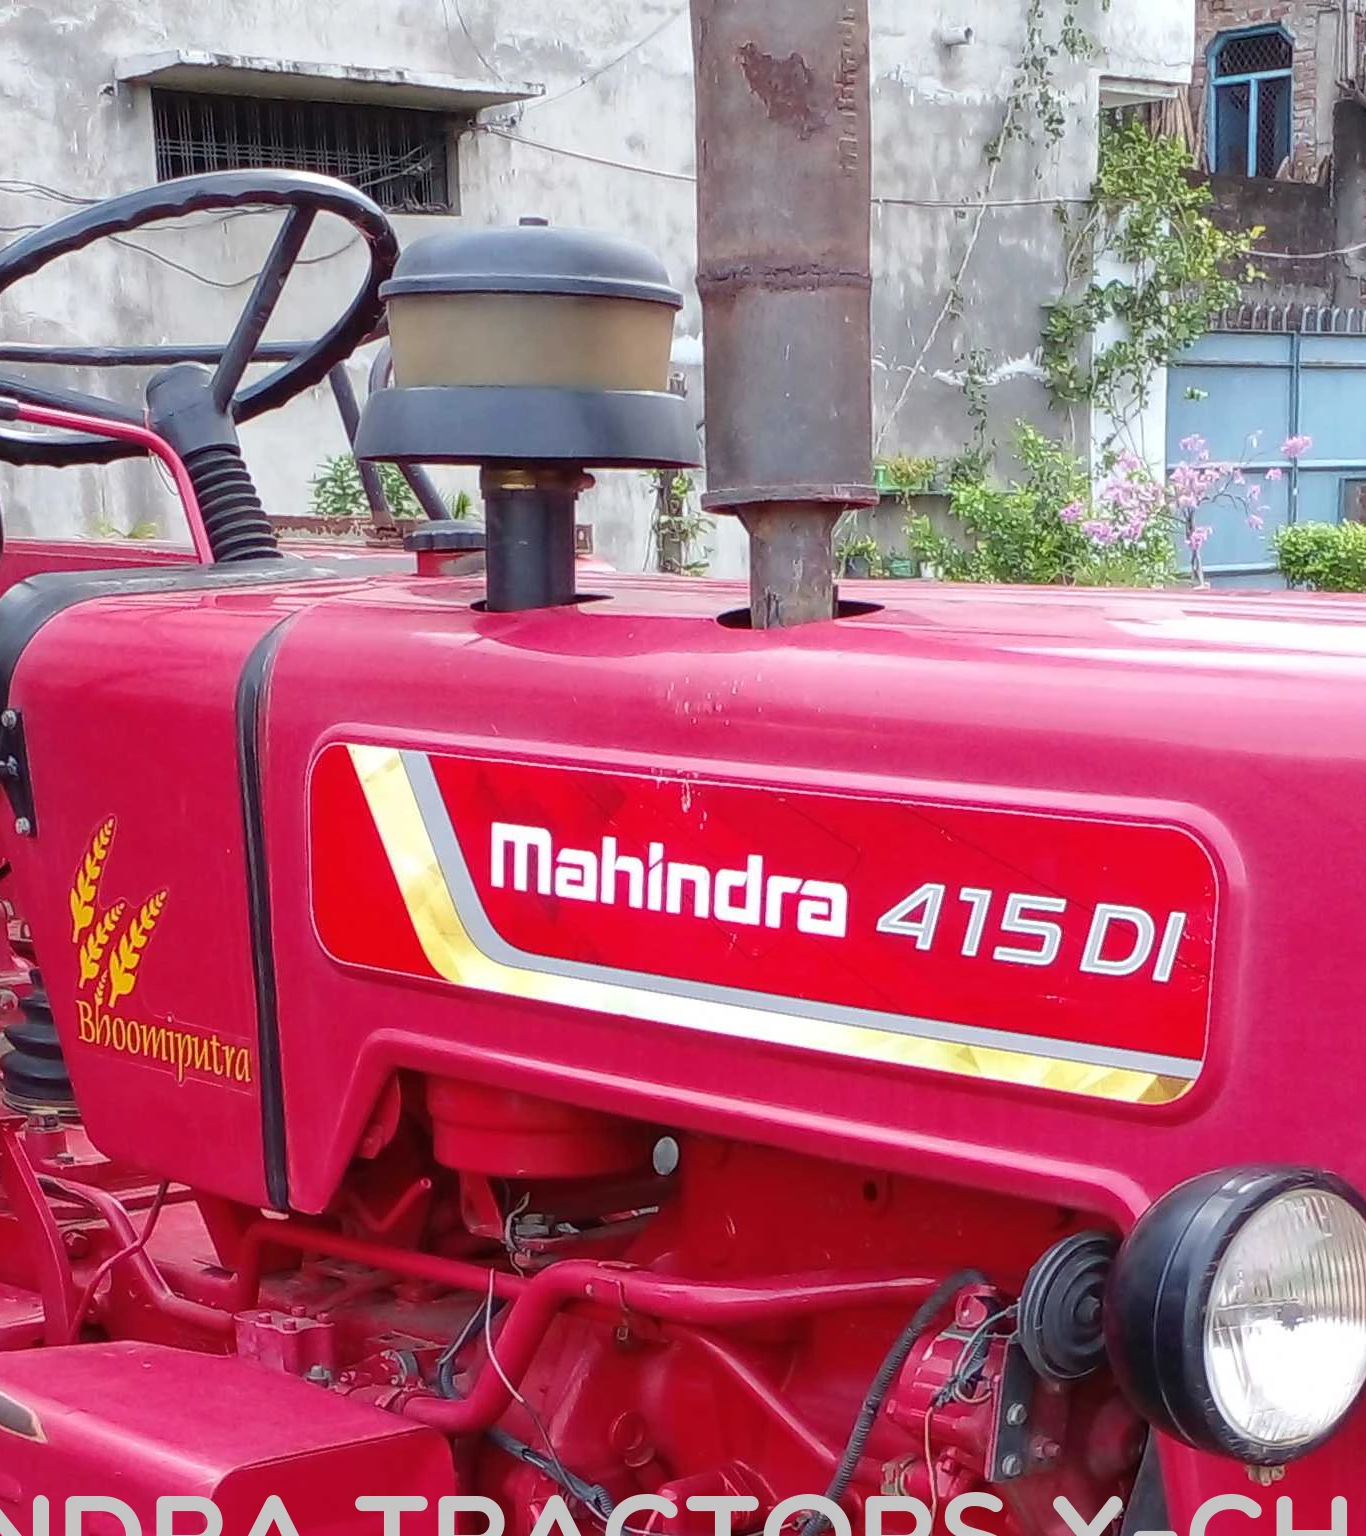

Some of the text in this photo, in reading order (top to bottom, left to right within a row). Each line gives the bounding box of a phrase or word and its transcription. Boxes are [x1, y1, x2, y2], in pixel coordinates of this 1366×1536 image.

[490, 821, 1187, 982] Mahindra 415 DI
[75, 1000, 252, 1083] Bhoomiputra
